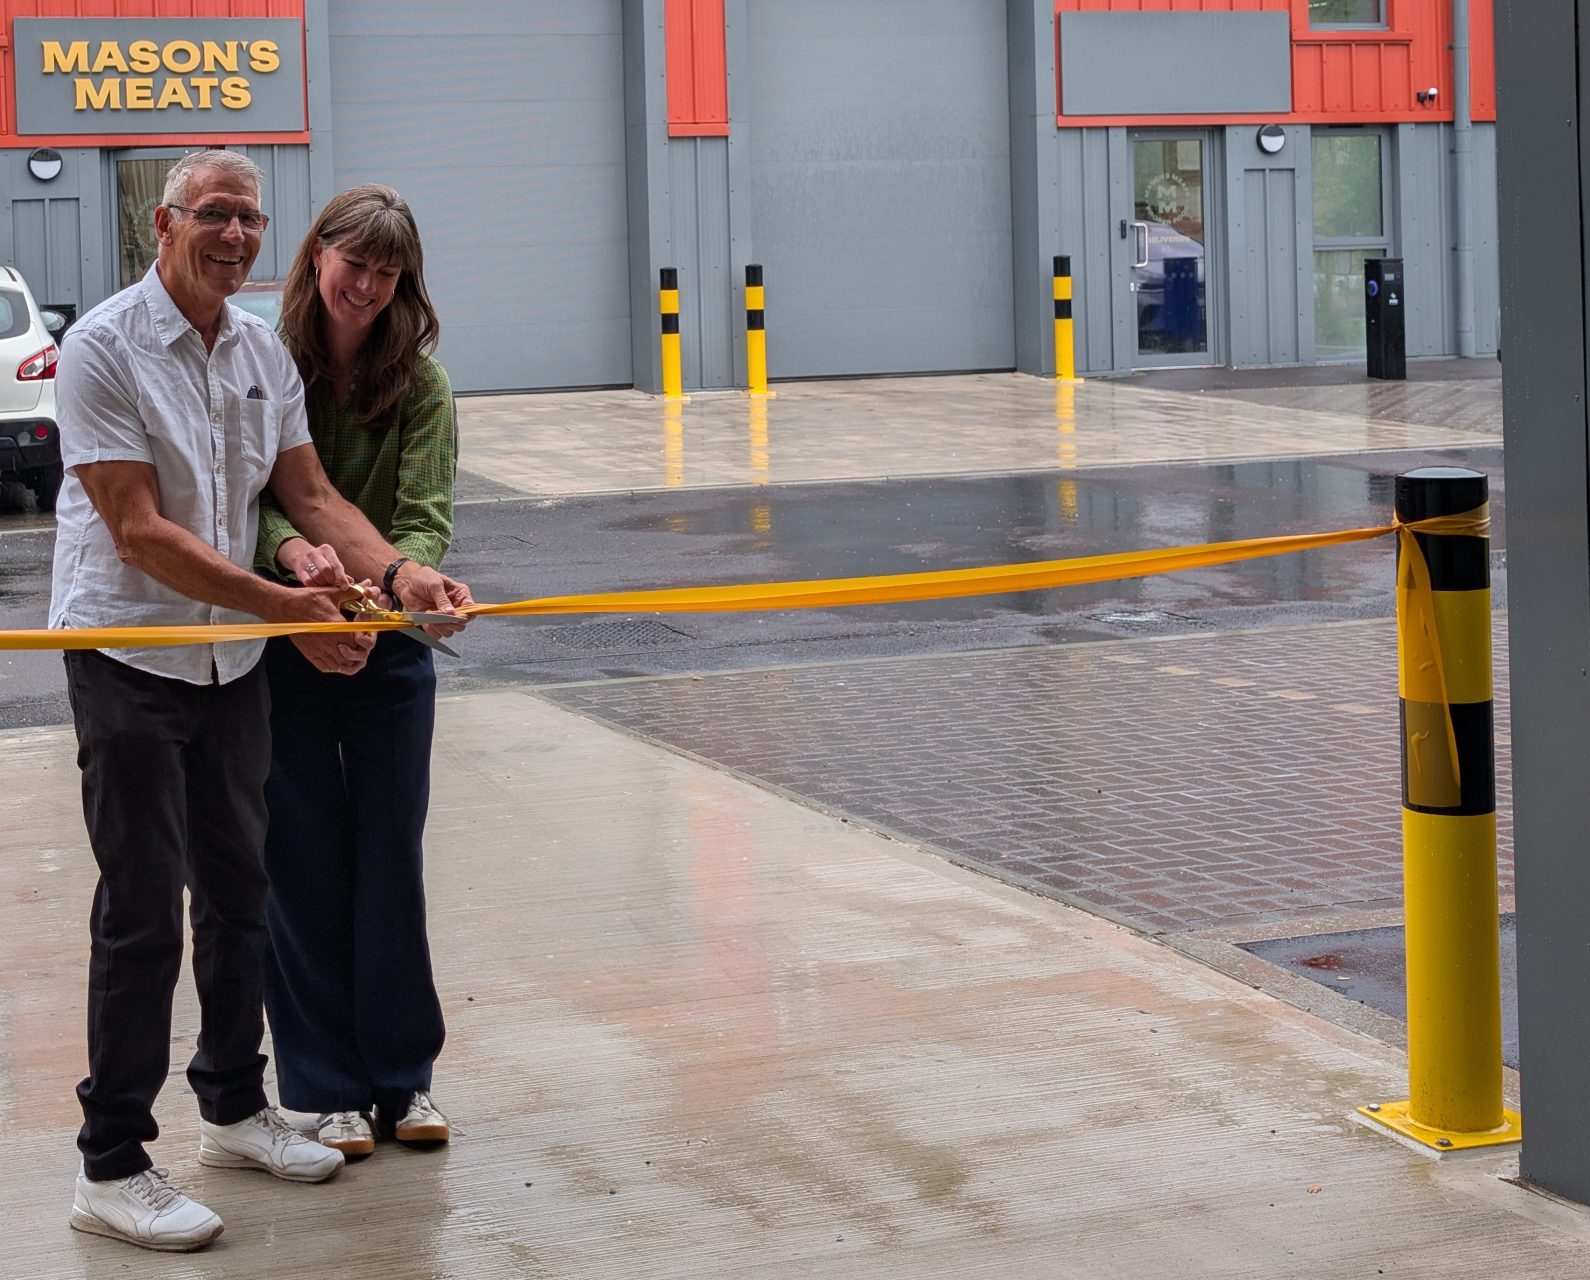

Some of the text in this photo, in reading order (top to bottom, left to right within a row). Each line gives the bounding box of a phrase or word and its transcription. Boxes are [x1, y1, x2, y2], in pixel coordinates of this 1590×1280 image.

[41, 39, 281, 74] MASON'S
[74, 76, 252, 110] MEATS
[1157, 184, 1177, 198] M
[1158, 201, 1178, 214] M
